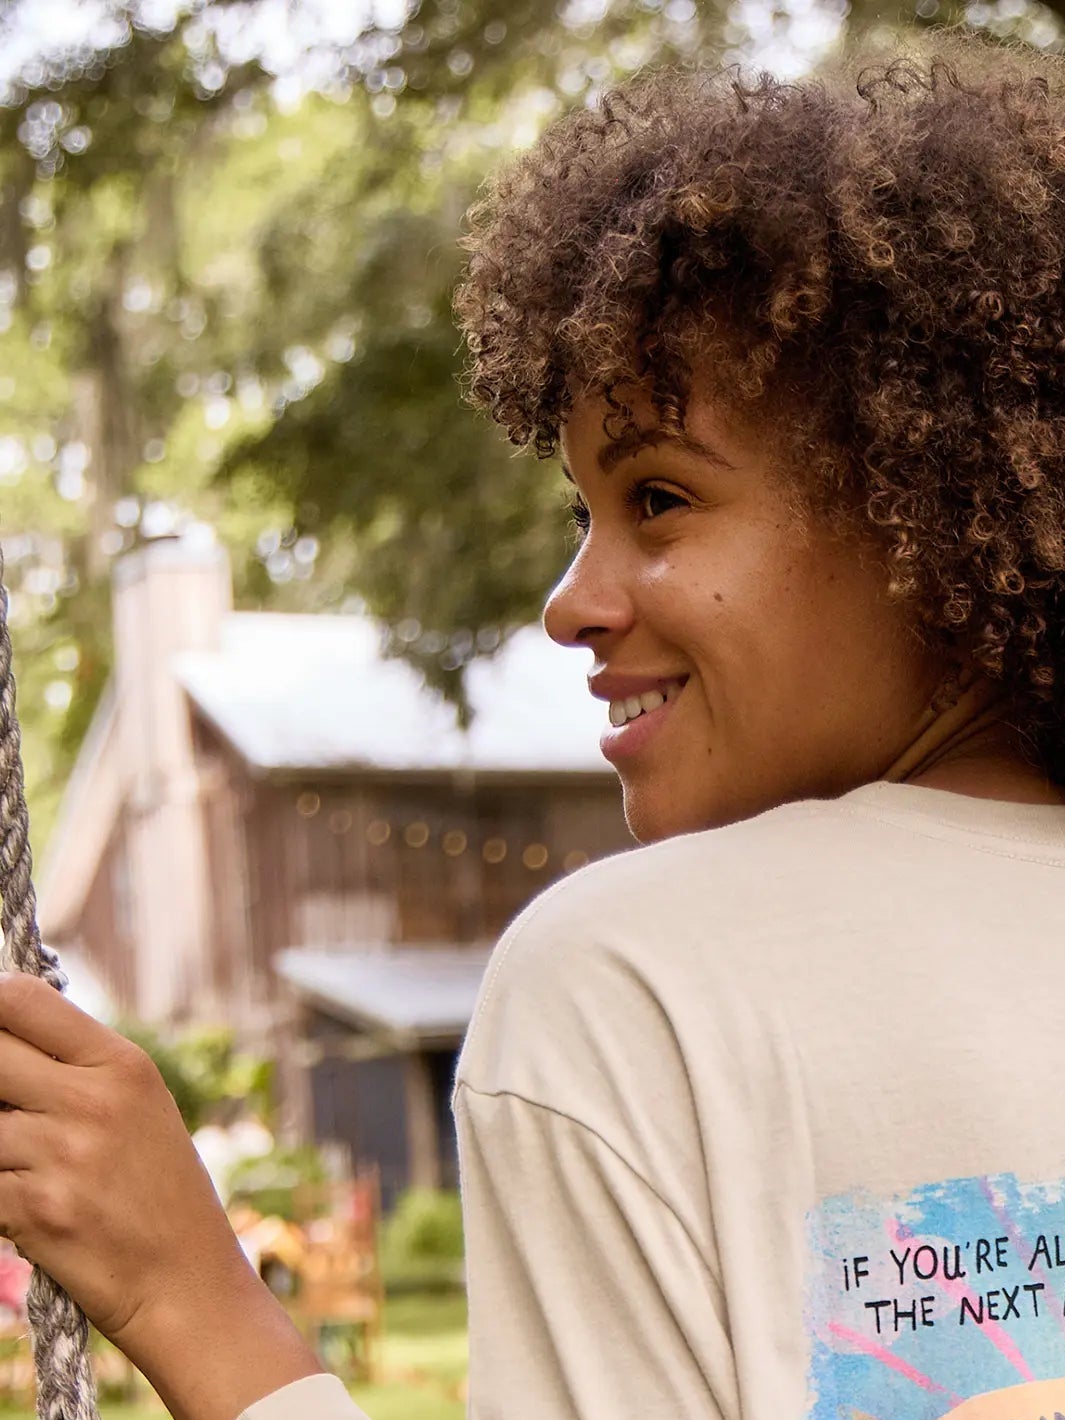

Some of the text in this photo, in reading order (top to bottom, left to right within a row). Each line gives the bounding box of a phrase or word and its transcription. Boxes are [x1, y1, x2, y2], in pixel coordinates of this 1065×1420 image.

[889, 1236, 1010, 1285] YOU'RE
[864, 1295, 936, 1334] THE
[958, 1283, 1045, 1326] NEXT
